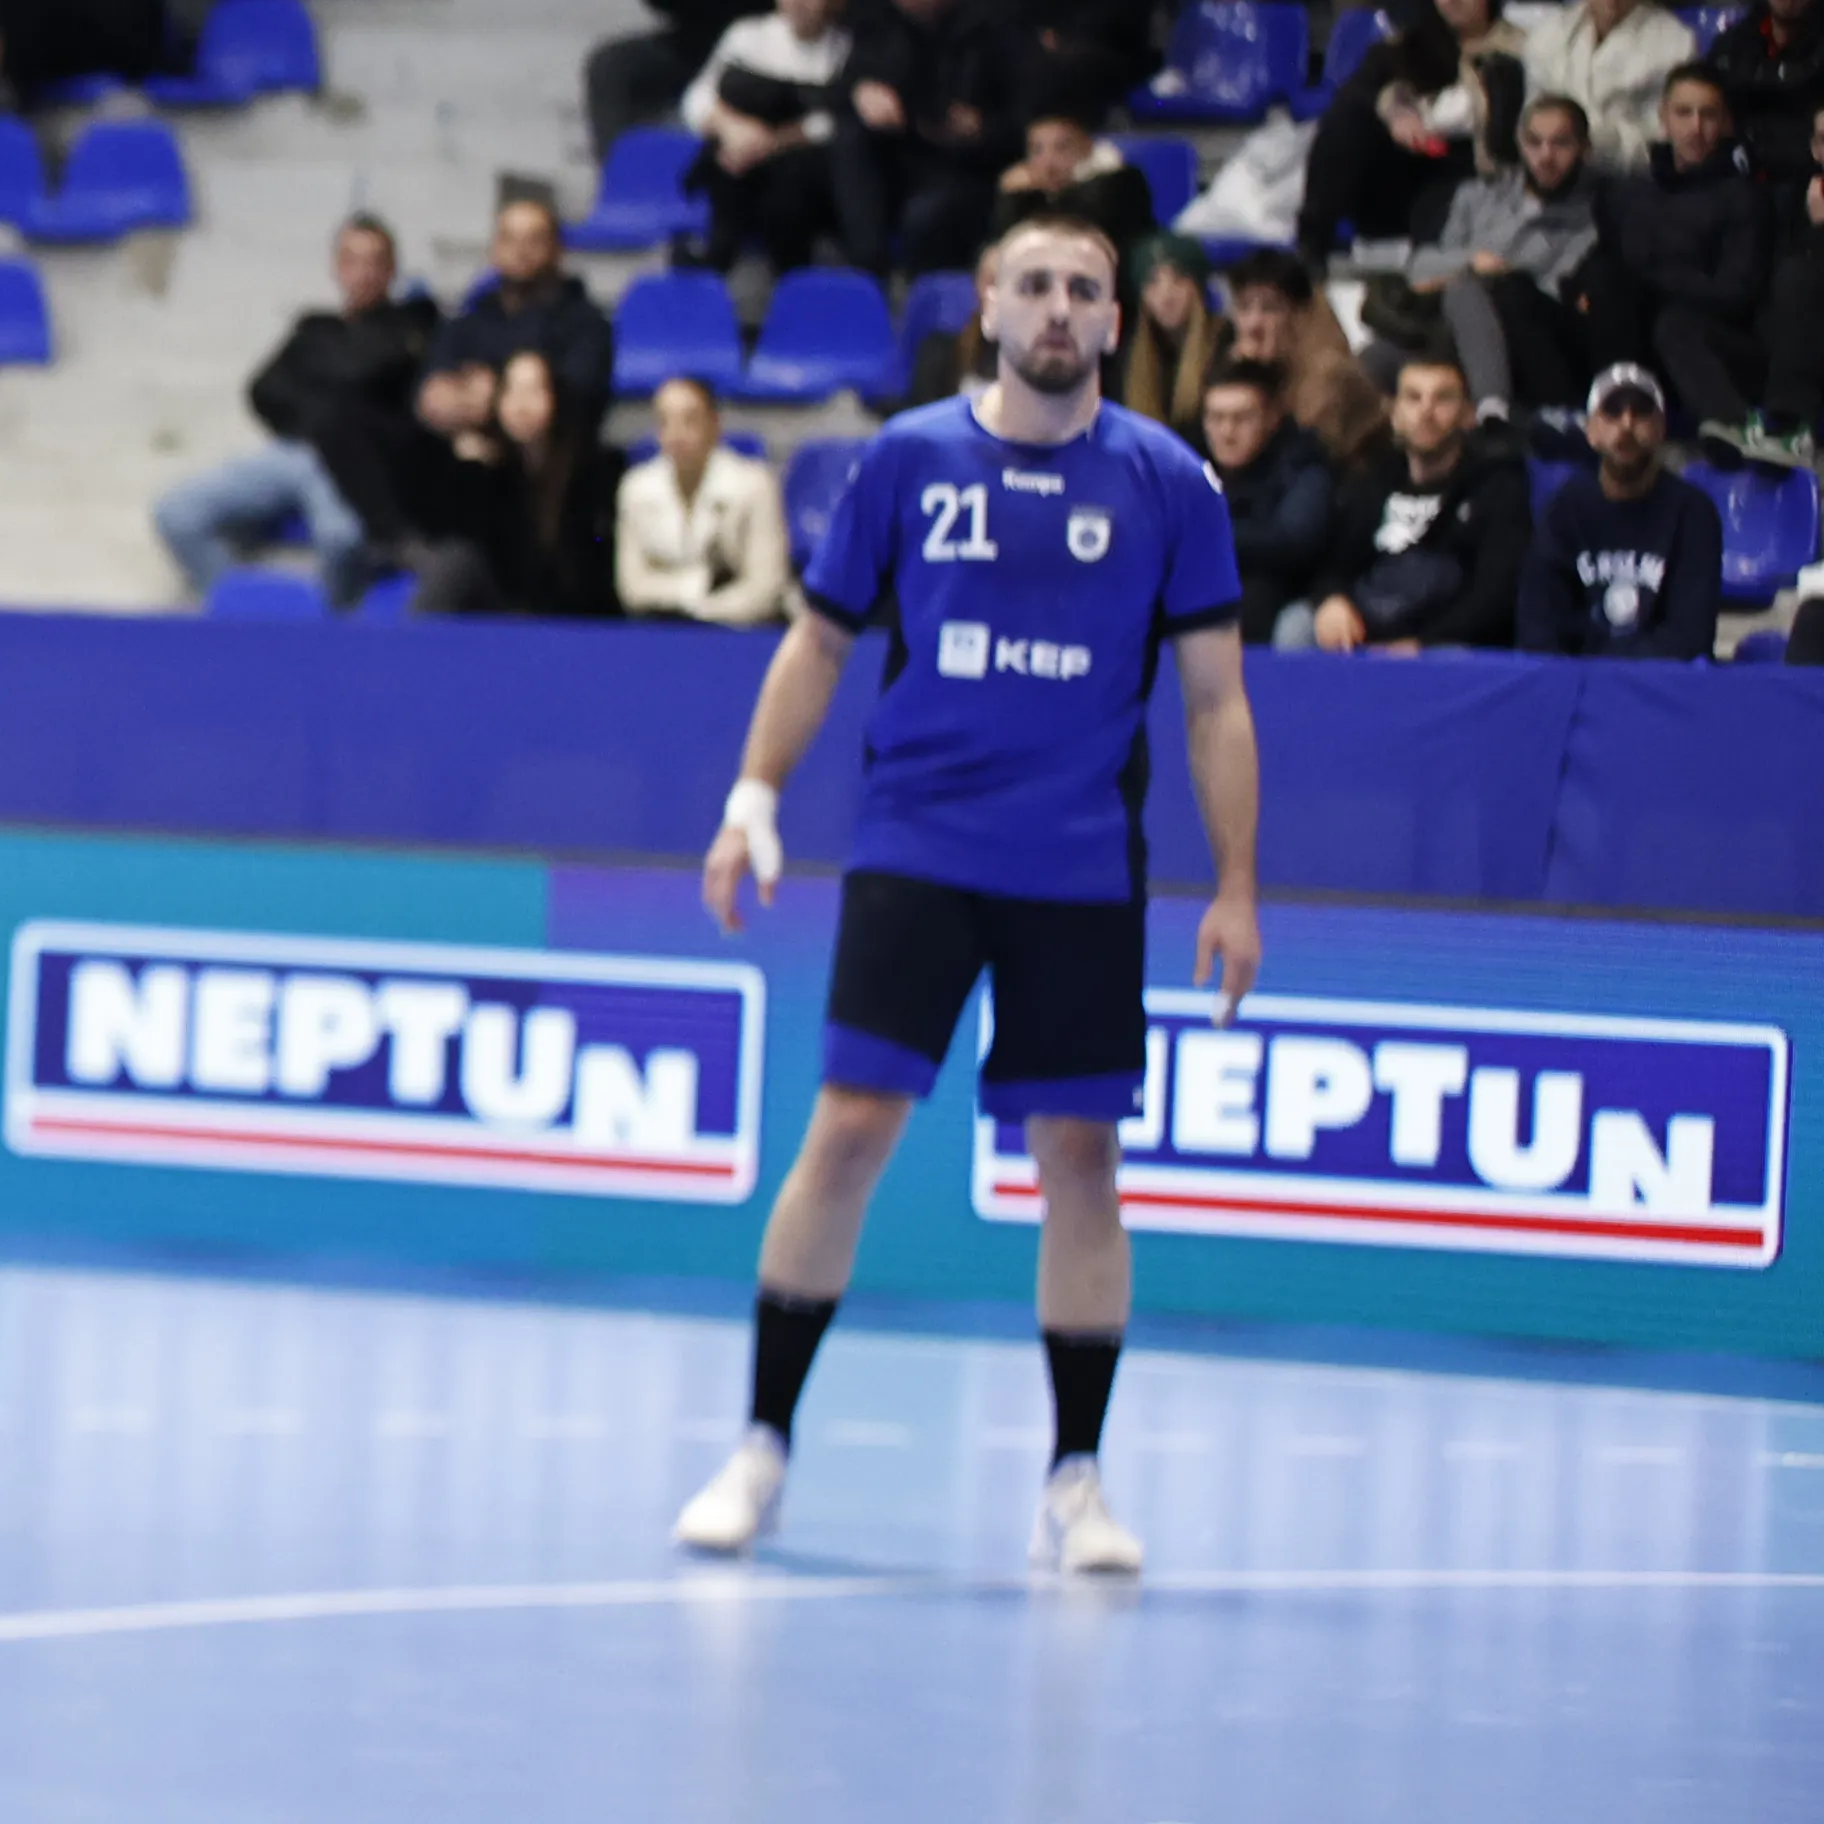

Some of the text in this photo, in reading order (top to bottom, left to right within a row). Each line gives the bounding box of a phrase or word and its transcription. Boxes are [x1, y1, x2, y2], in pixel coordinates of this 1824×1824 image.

[920, 481, 999, 563] 21
[995, 635, 1092, 681] KEP
[65, 958, 699, 1149] NEPTUN
